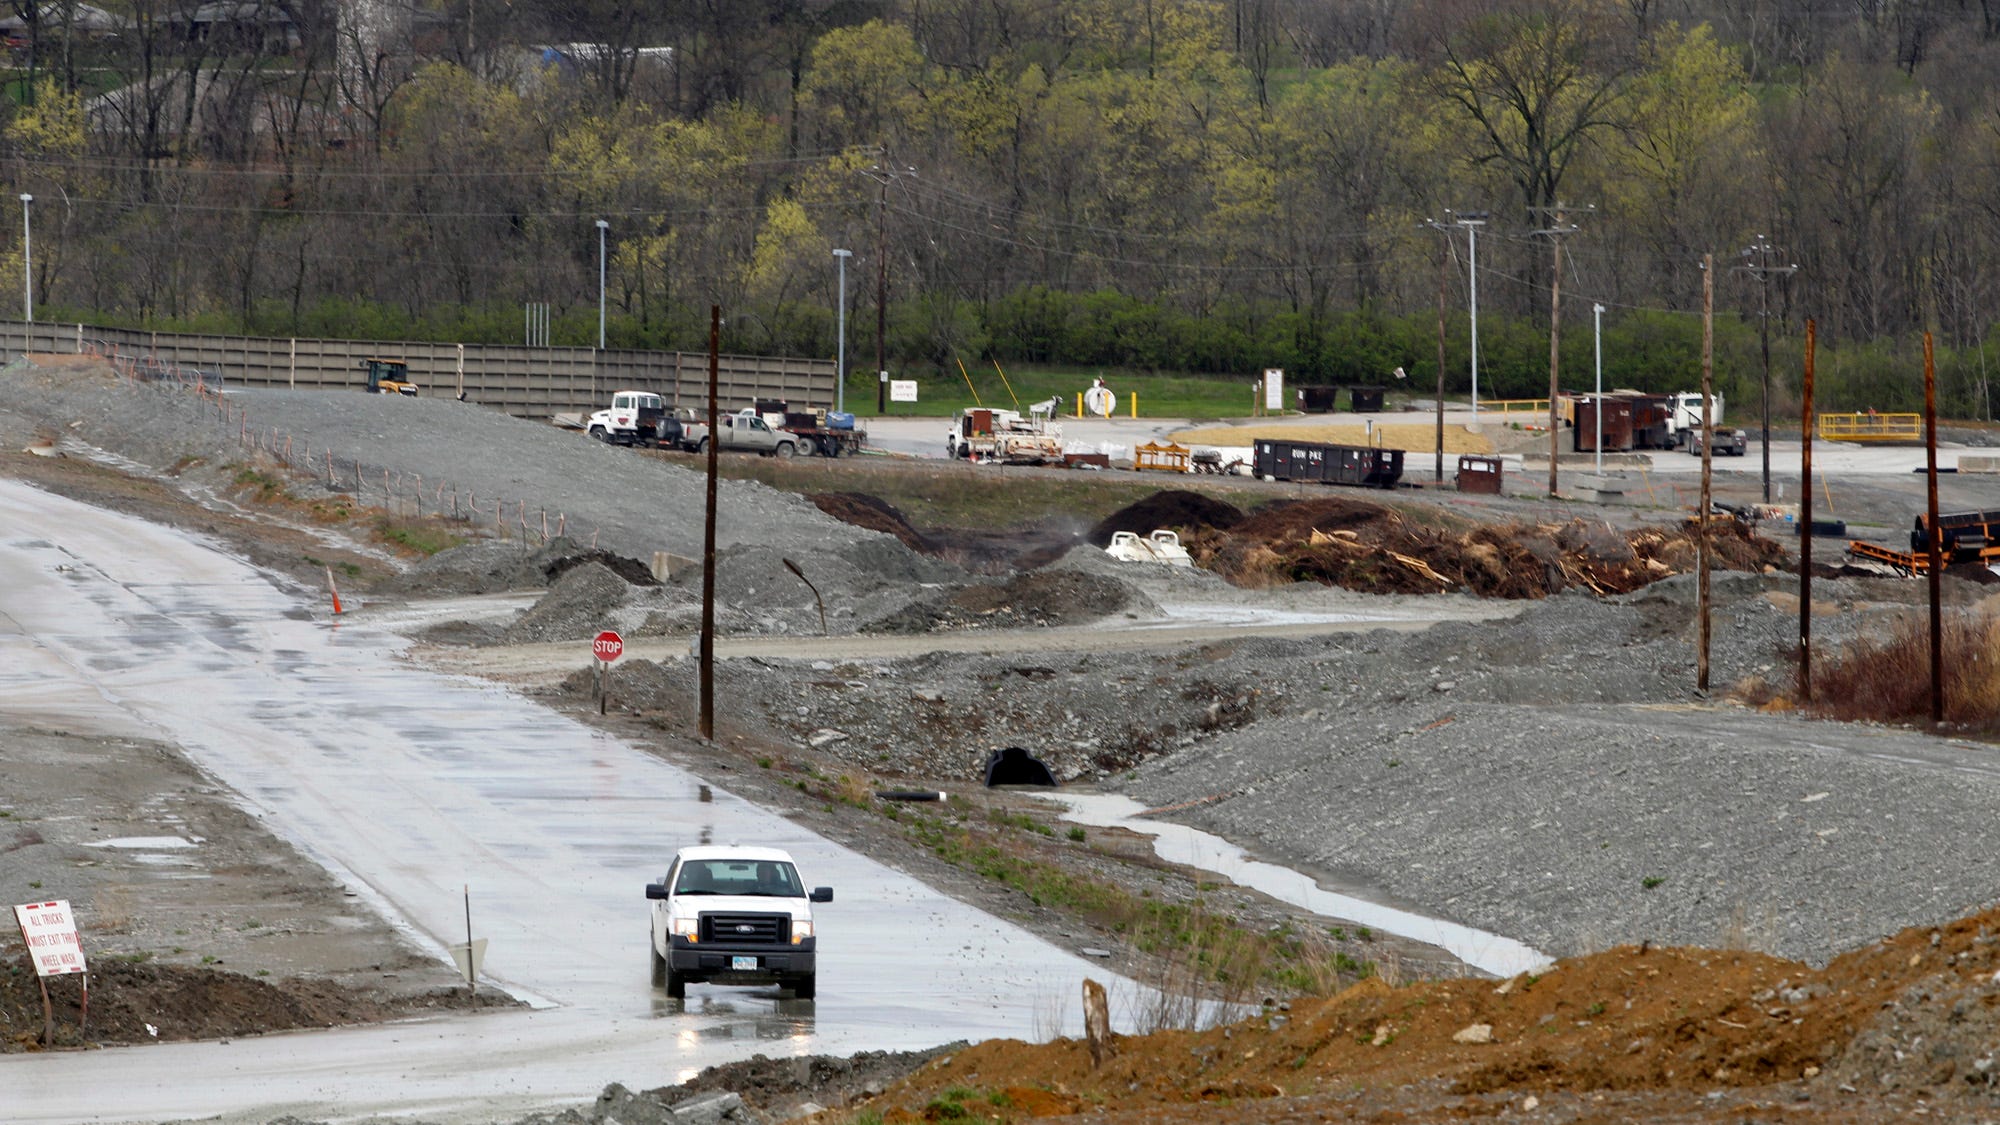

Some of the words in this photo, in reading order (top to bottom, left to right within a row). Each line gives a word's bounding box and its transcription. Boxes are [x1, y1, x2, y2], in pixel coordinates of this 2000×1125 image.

[595, 640, 622, 653] STOP
[30, 915, 41, 926] ALL
[42, 913, 64, 925] TRUCKS
[31, 934, 47, 947] MUST
[47, 933, 61, 945] EXIT
[41, 954, 60, 967] WHEEL
[60, 952, 76, 964] WASH
